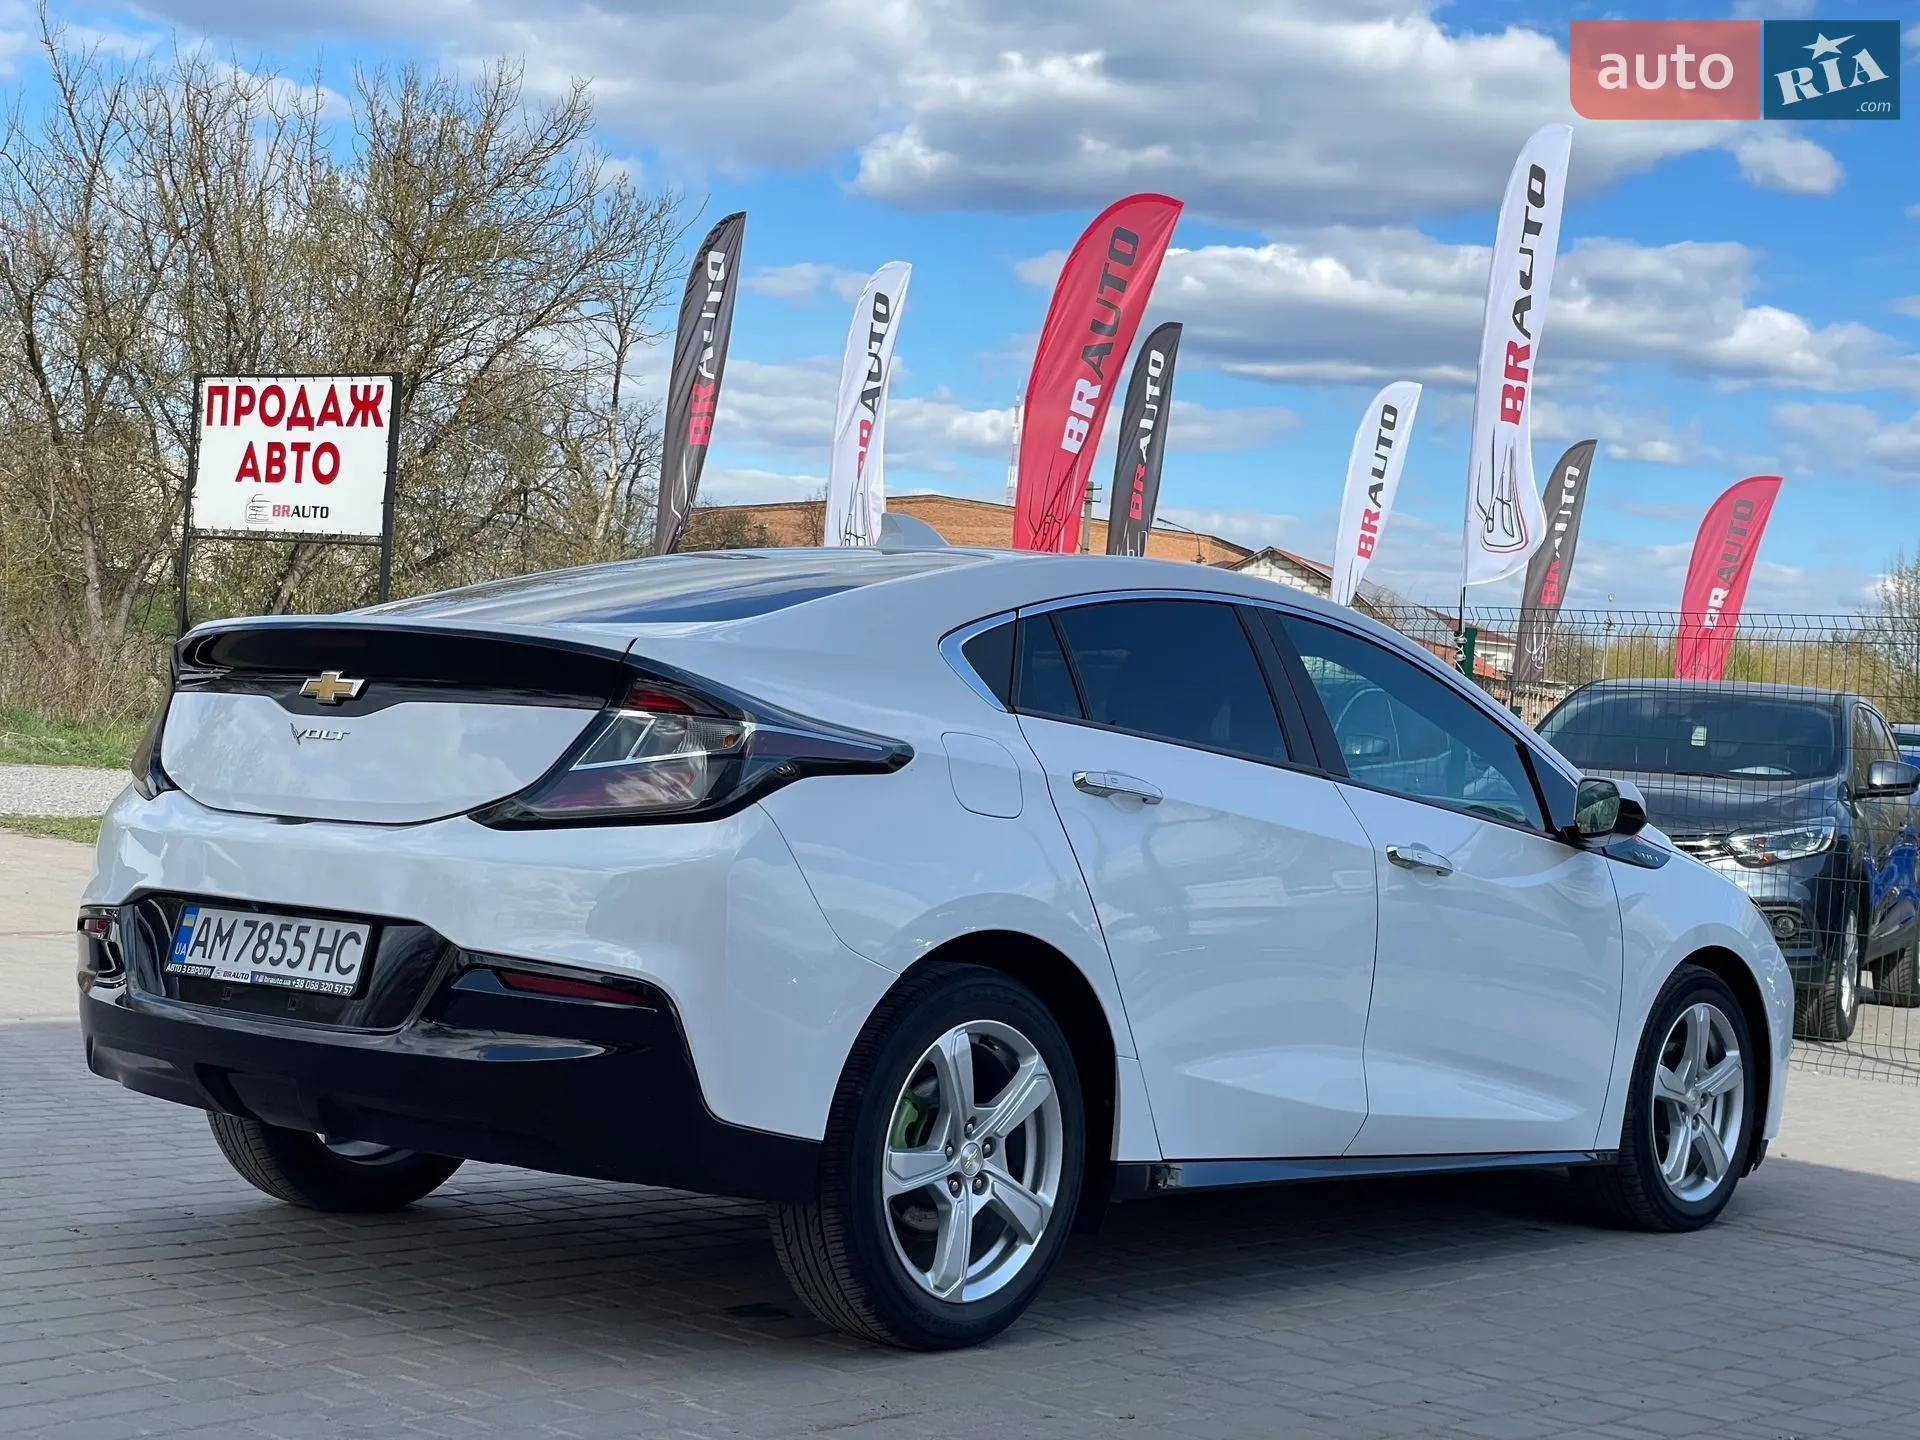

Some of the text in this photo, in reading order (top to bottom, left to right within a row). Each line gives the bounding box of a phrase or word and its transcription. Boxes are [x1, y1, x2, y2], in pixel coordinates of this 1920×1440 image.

[1500, 163, 1547, 425] BRAUTO
[1060, 226, 1140, 454] BRAUTO
[206, 384, 384, 431] ПРОДАЖ
[1129, 349, 1165, 520] BRAUTO
[235, 441, 341, 485] АВТО
[1356, 403, 1398, 560] BRAUTO
[272, 504, 329, 519] BRAUTO
[1704, 499, 1754, 630] BRAUTO
[290, 722, 351, 745] VOLT
[175, 942, 187, 957] UA
[223, 970, 250, 980] BRAUTO
